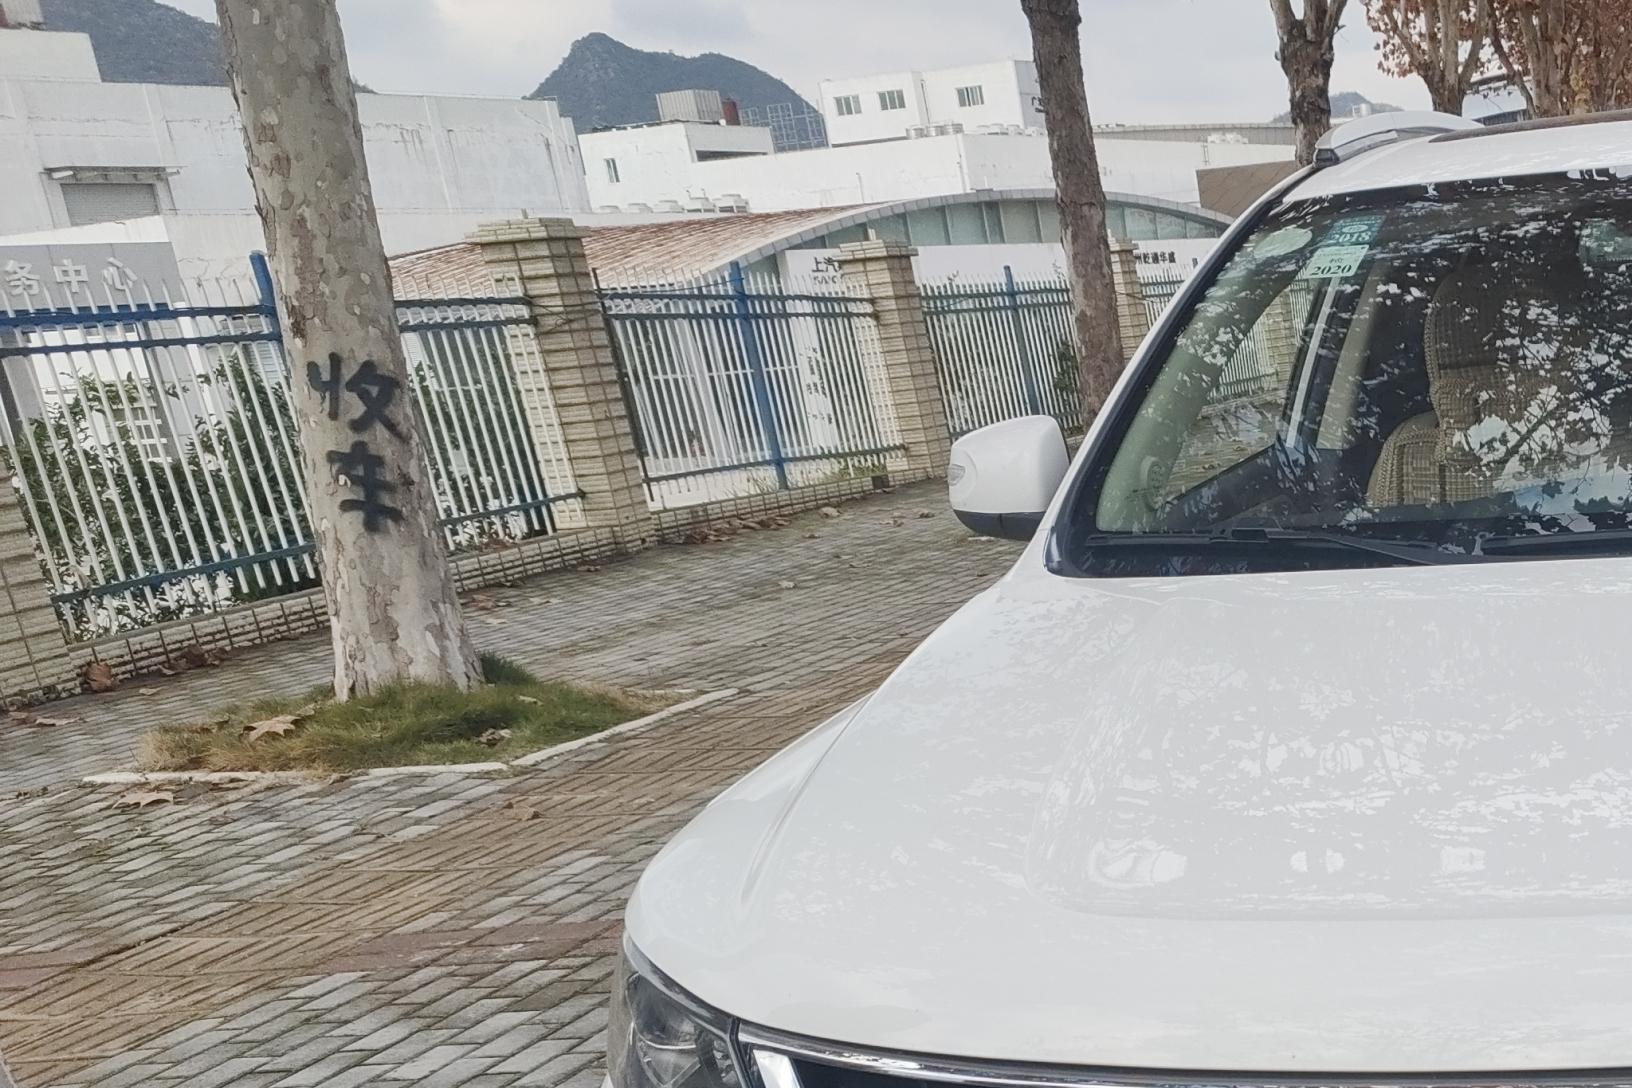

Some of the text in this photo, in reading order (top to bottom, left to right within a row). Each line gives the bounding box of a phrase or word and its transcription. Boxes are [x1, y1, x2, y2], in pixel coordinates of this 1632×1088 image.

[4, 256, 138, 296] 务中心
[1310, 264, 1352, 276] 2020
